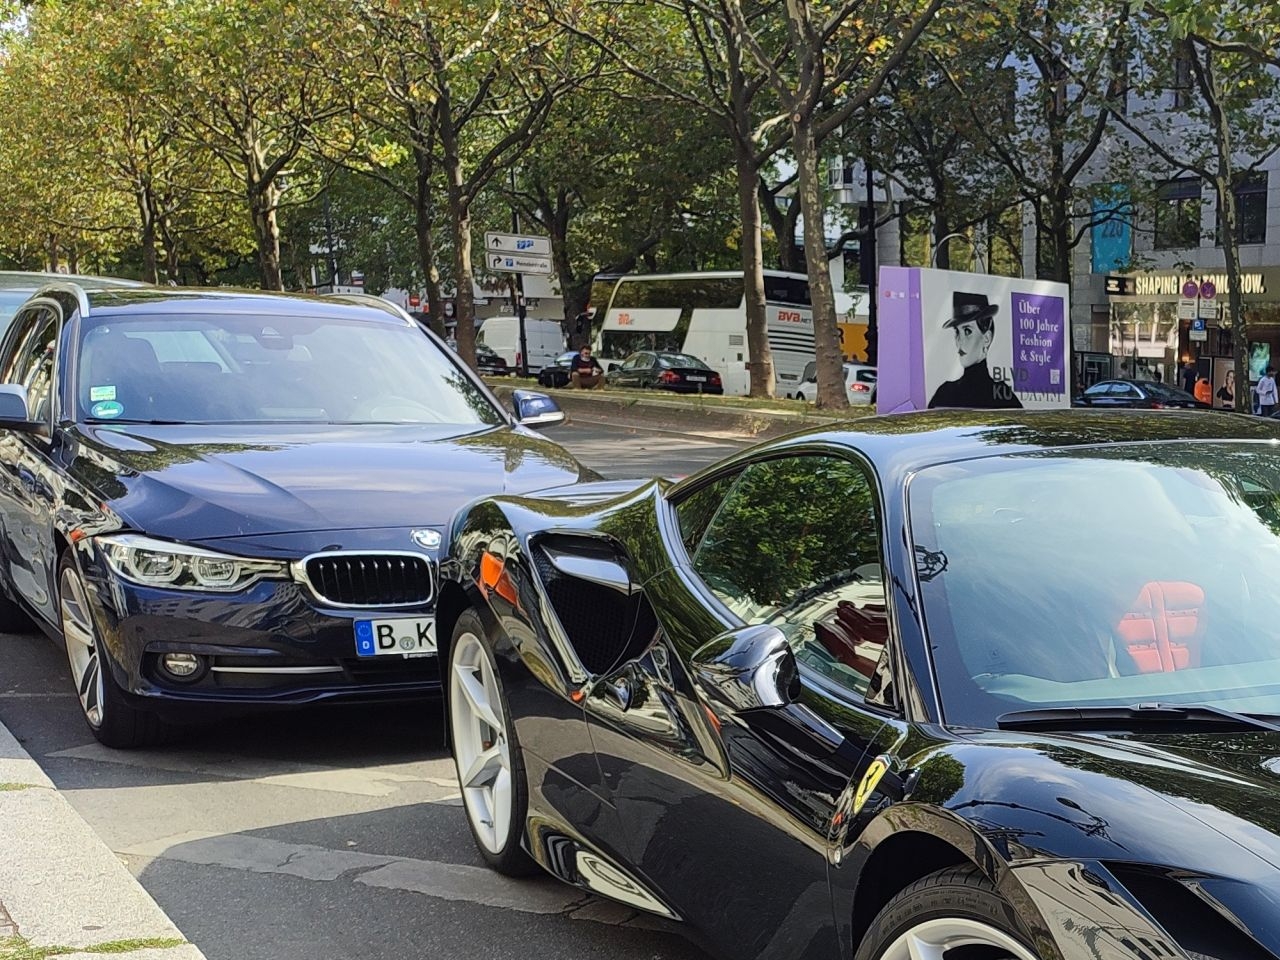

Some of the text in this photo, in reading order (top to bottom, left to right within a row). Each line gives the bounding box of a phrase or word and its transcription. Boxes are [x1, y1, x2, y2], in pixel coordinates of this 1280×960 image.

[1135, 275, 1178, 295] SHAPING
[1019, 300, 1041, 314] Über
[1020, 319, 1059, 333] 100 Jahre
[1020, 334, 1052, 348] Fashion
[1020, 350, 1051, 366] & Style
[992, 367, 1029, 382] BLVD
[992, 384, 1061, 402] KUDAMM
[376, 621, 435, 650] B K
